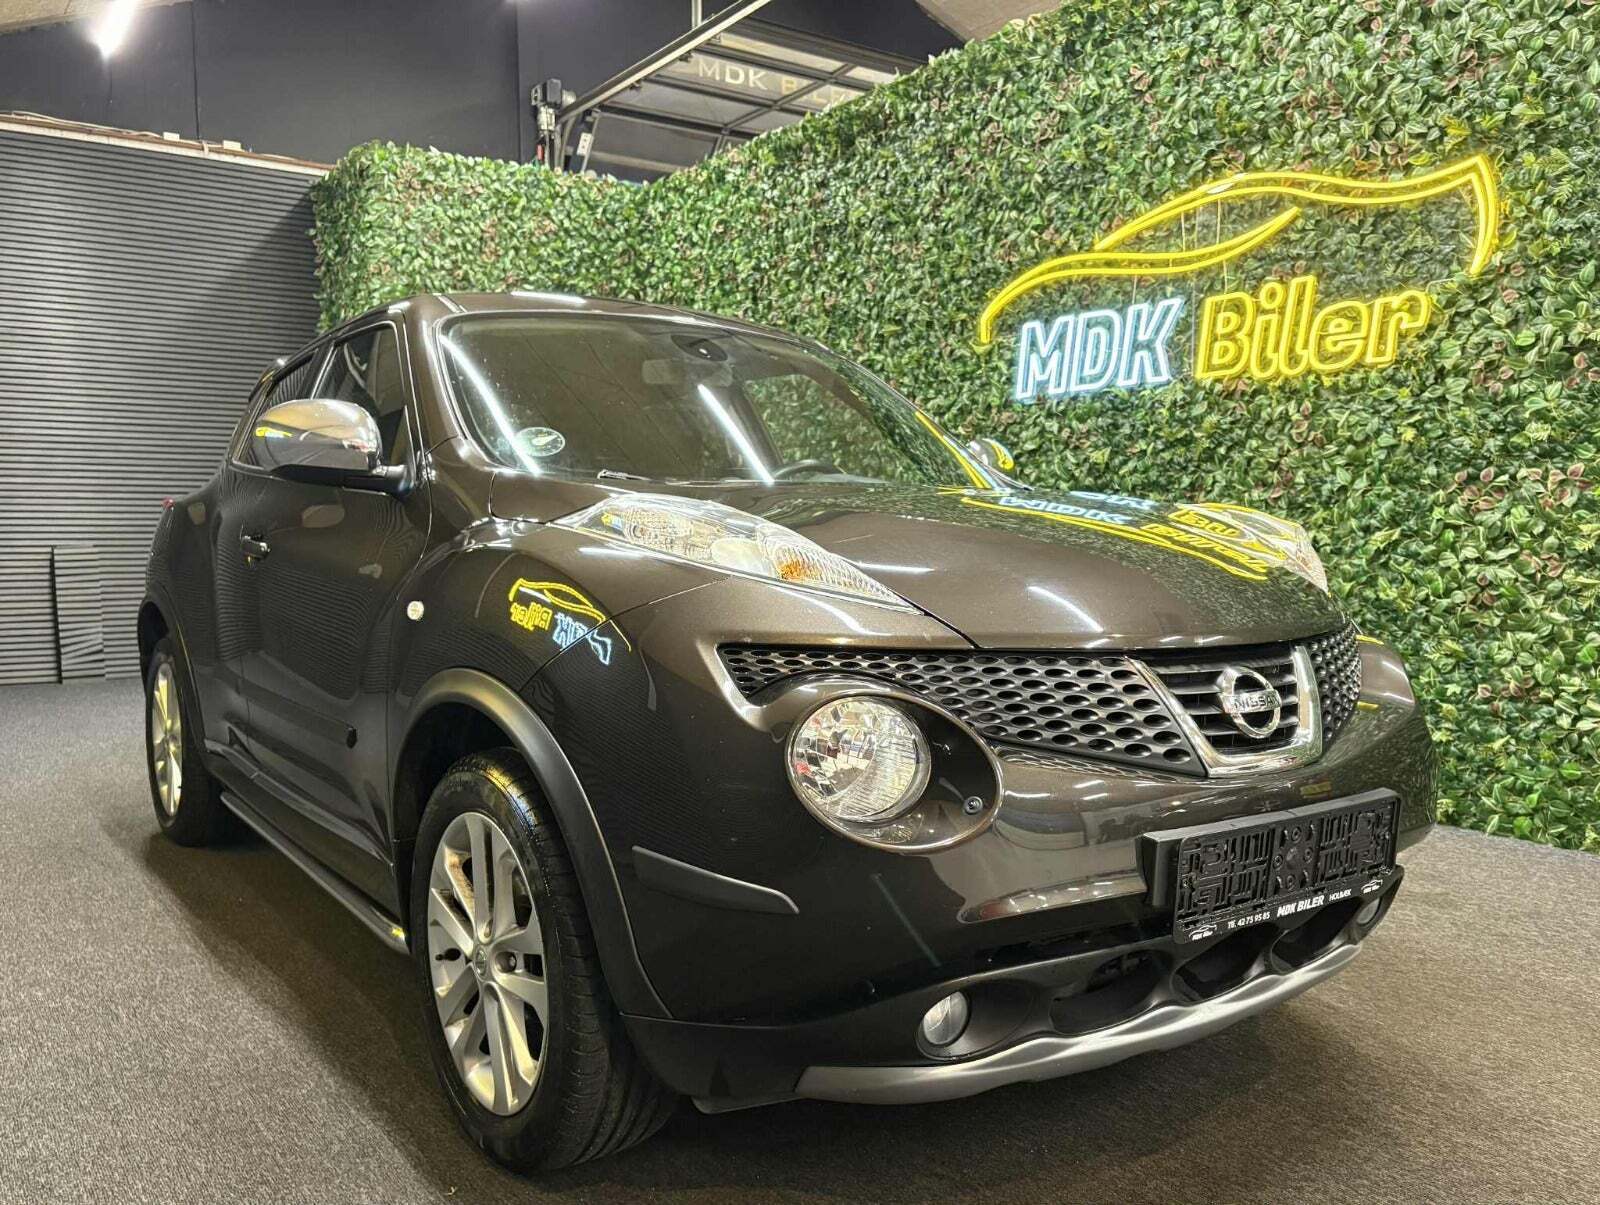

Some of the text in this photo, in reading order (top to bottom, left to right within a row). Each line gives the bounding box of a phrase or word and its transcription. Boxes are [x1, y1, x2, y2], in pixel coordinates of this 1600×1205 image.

[699, 59, 767, 90] MDK
[1015, 275, 1431, 400] MDK Biler
[1237, 917, 1246, 926] 42
[1246, 915, 1254, 925] 75
[1254, 913, 1263, 922] 95
[1263, 911, 1271, 920] 85
[1276, 902, 1297, 918] MDK
[1297, 895, 1325, 912] BILER
